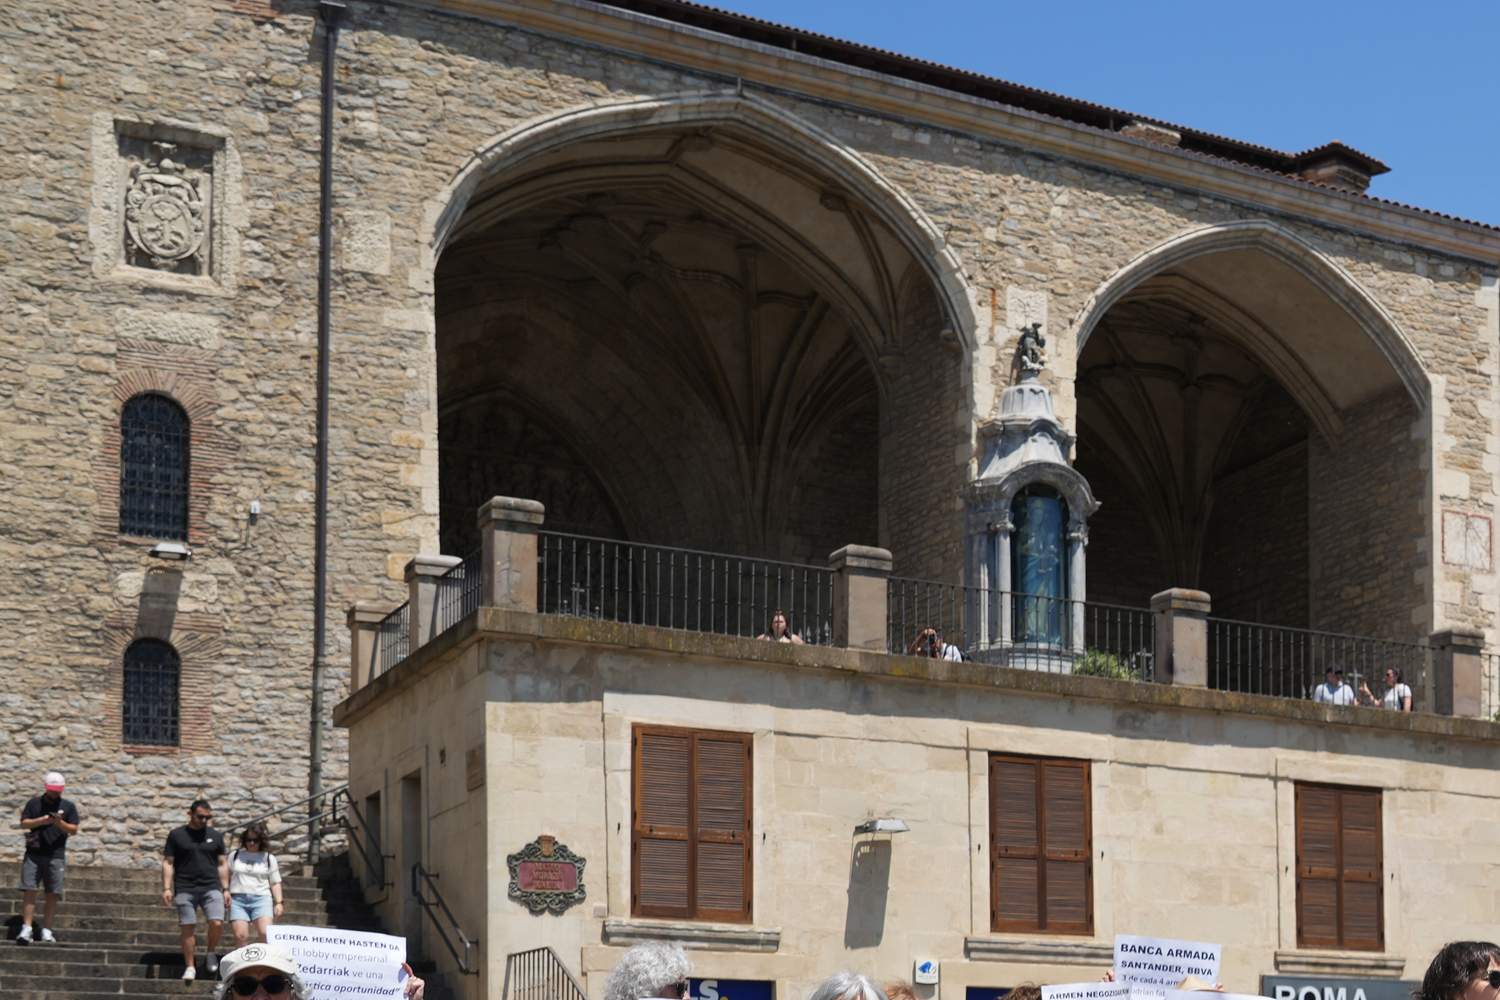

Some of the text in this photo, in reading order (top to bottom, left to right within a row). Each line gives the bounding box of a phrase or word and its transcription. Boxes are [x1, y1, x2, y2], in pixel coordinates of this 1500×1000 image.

[274, 934, 309, 942] GERRA
[312, 936, 346, 945] HEMEN
[349, 940, 387, 948] HASTEN
[292, 948, 388, 964] El lobby empresarial
[1120, 944, 1216, 962] BANCA ARMADA
[297, 963, 350, 976] Zedarriak
[366, 972, 383, 980] una
[1121, 960, 1213, 976] SANTANDER, BBVA
[304, 980, 332, 991] ástica
[1128, 974, 1138, 982] de
[1140, 977, 1158, 985] cada
[1049, 991, 1083, 1000] ARMEN
